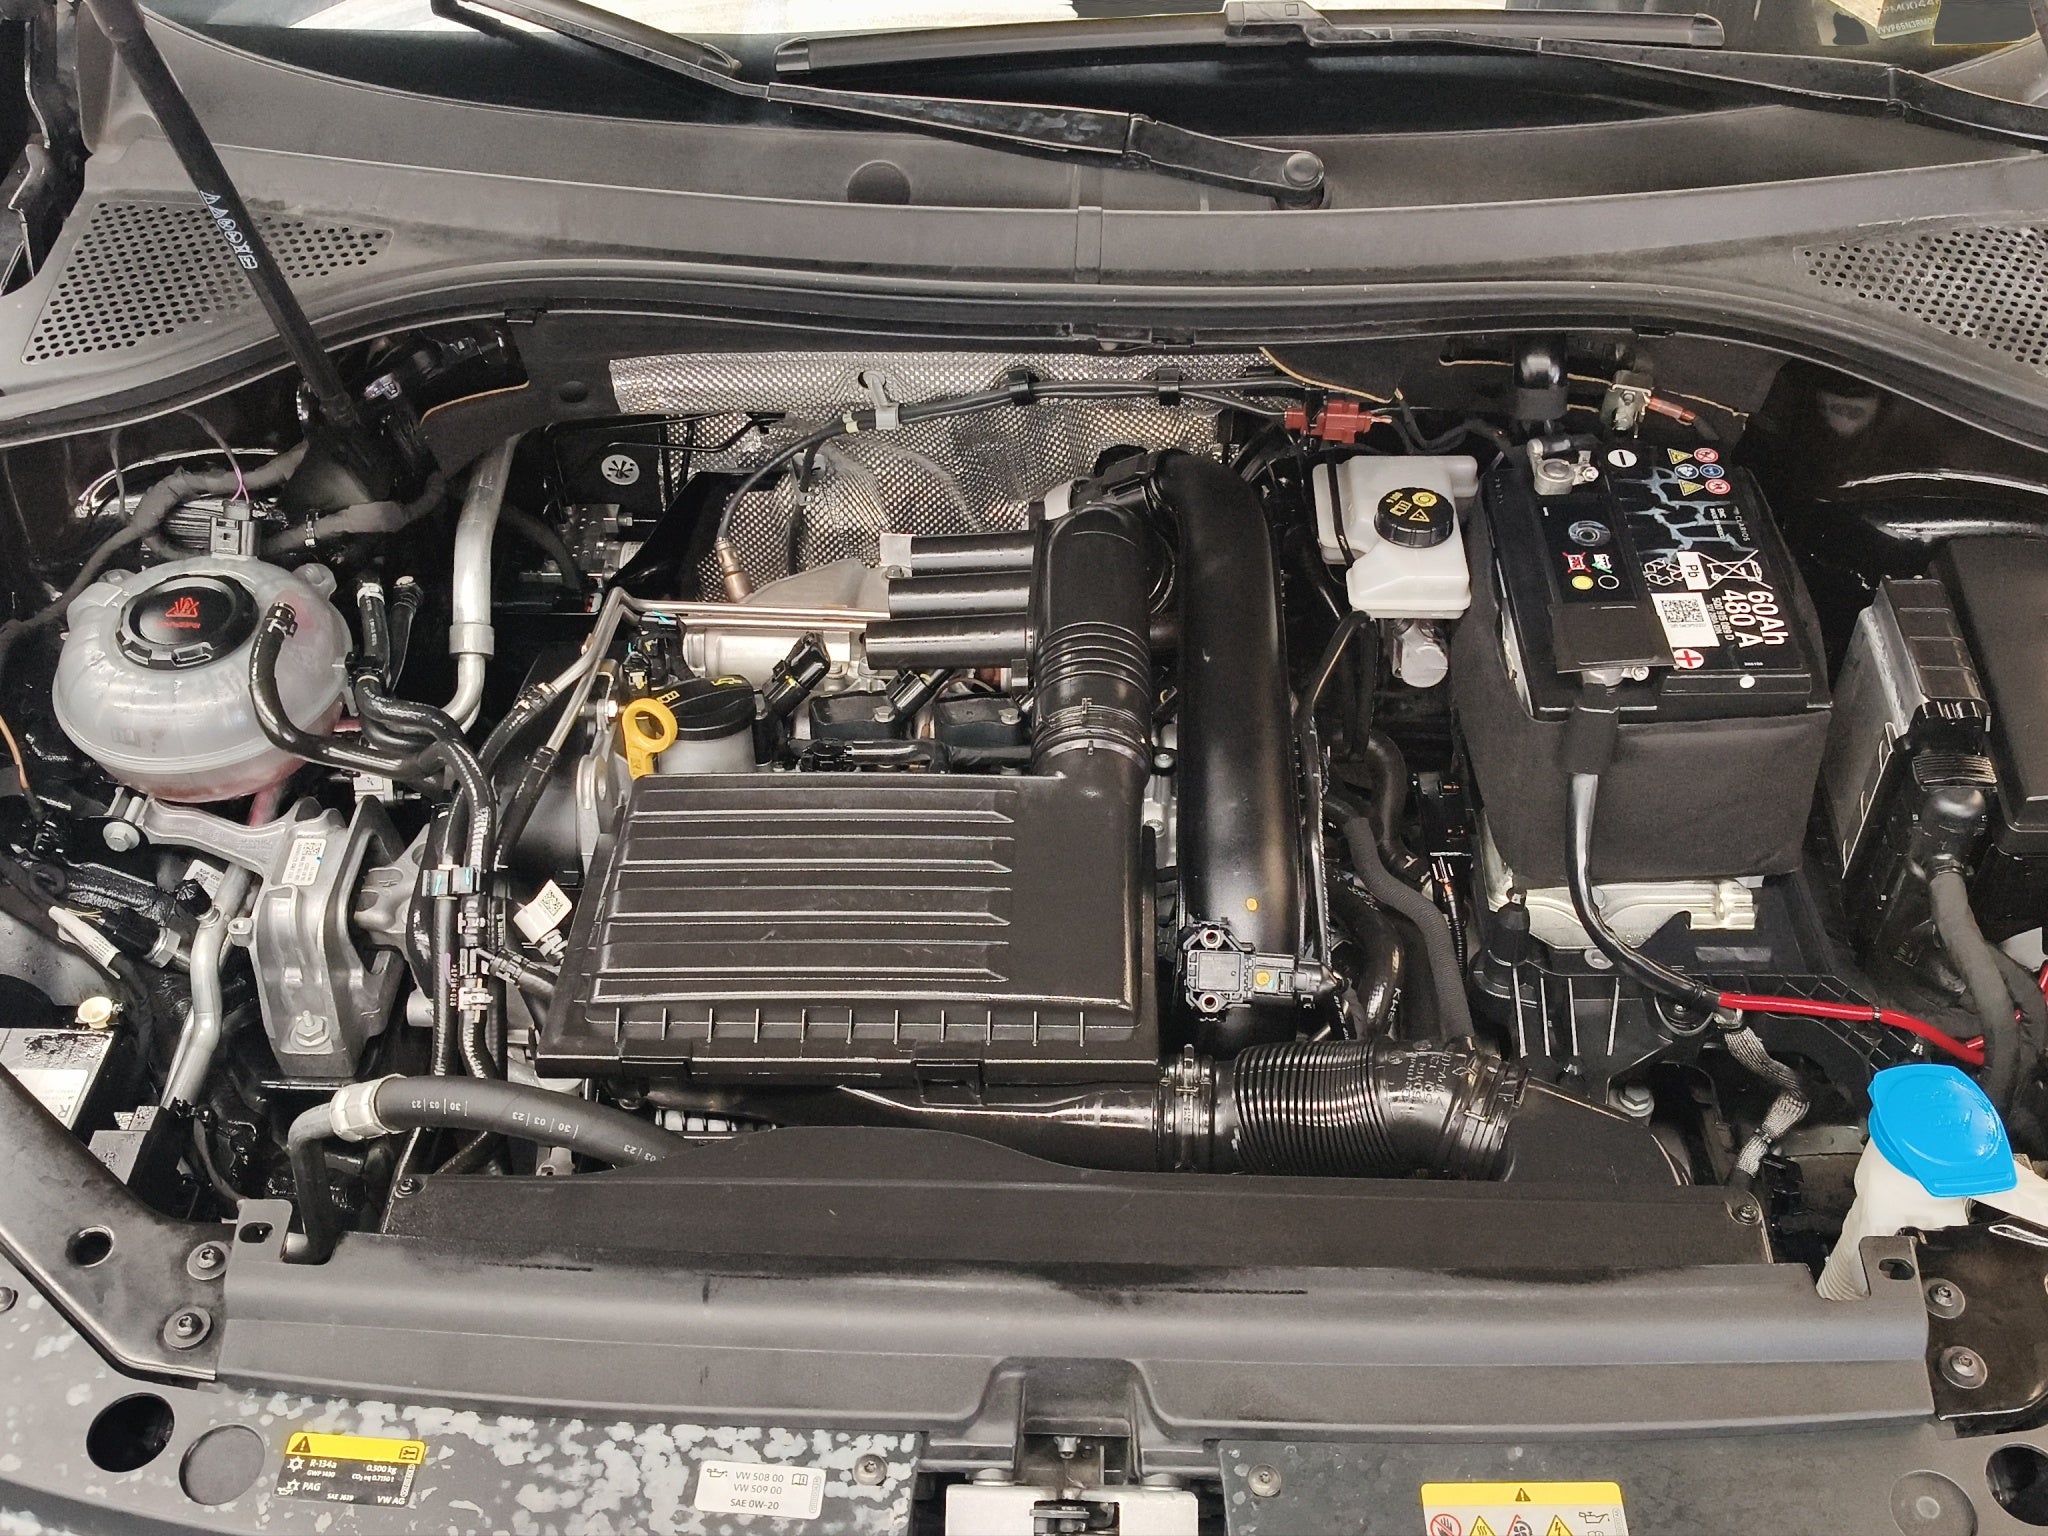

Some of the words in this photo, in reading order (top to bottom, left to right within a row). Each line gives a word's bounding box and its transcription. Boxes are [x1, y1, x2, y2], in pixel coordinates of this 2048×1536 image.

[1735, 515, 1751, 541] CLARIOS
[1685, 564, 1699, 578] Pb
[1721, 589, 1756, 627] 480
[1747, 590, 1789, 645] 60Ah
[1734, 631, 1763, 648] A
[411, 1100, 422, 1109] 23
[429, 1100, 440, 1110] 03
[449, 1102, 462, 1112] 30
[512, 1111, 525, 1122] 23
[533, 1117, 546, 1127] 03
[558, 1123, 571, 1133] 30
[623, 1144, 636, 1154] 23
[644, 1151, 657, 1162] 03
[306, 1469, 322, 1477] GWP
[309, 1459, 337, 1469] R-134a
[366, 1464, 387, 1473] 0.500
[387, 1465, 398, 1476] kg
[735, 1471, 751, 1480] VW
[753, 1472, 770, 1482] 508
[772, 1474, 784, 1483] 00
[302, 1481, 321, 1492] PAG
[733, 1483, 749, 1492] VW
[751, 1484, 768, 1494] 509
[770, 1485, 782, 1495] 00
[377, 1496, 393, 1505] VW
[391, 1497, 406, 1505] AG
[730, 1498, 747, 1508] SAE
[748, 1499, 779, 1510] 0W-20
